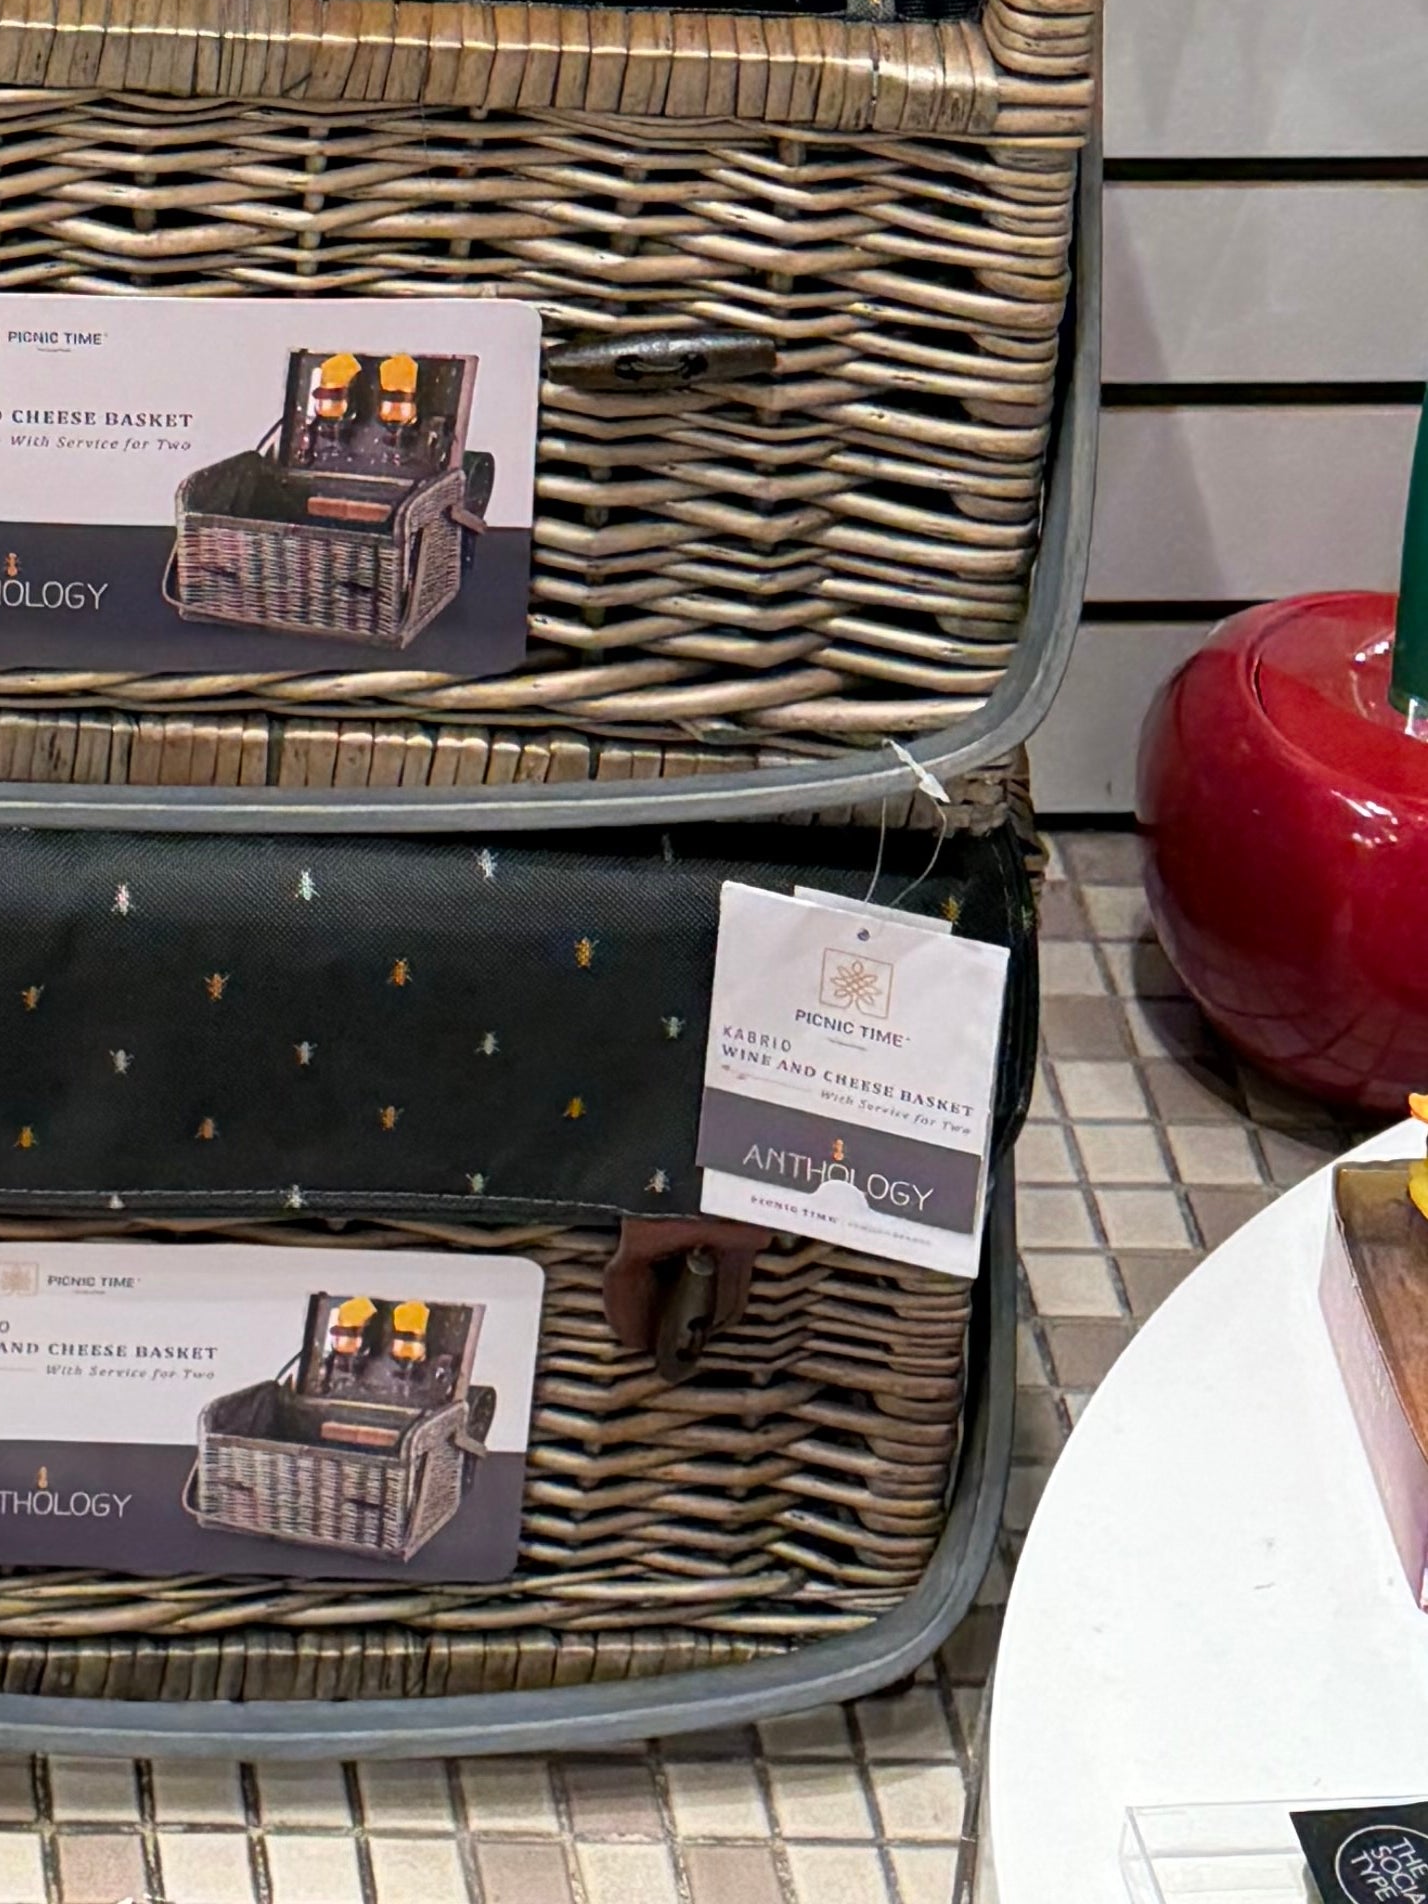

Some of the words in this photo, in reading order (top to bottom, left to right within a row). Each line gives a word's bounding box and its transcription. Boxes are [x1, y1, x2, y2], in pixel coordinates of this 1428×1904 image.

[7, 330, 59, 346] PICNIC
[63, 331, 103, 347] TIME
[11, 410, 96, 427] CHEESE
[104, 412, 194, 429] BASKET
[10, 434, 48, 449] With
[56, 435, 117, 451] Service
[123, 434, 148, 454] for
[156, 437, 192, 452] Two
[723, 1024, 792, 1053] KABRIO
[795, 1008, 855, 1036] PICNIC
[858, 1024, 906, 1049] TIME
[722, 1044, 772, 1067] WINE
[777, 1059, 817, 1079] AND
[823, 1070, 894, 1099] CHEESE
[901, 1089, 974, 1119] BASKET
[820, 1090, 854, 1107] With
[858, 1098, 910, 1121] Service
[913, 1108, 938, 1128] for
[941, 1119, 972, 1136] Two
[743, 1143, 935, 1212] ANTHOLOGY
[751, 1195, 799, 1213] PICNIC
[47, 1274, 96, 1288] PICNIC
[100, 1275, 136, 1289] TIME
[48, 1343, 129, 1359] CHEESE
[136, 1345, 219, 1361] BASKET
[46, 1364, 83, 1378] With
[89, 1364, 147, 1380] Service
[152, 1364, 176, 1382] for
[184, 1367, 215, 1381] Two
[1392, 1836, 1428, 1879] THE
[1351, 1850, 1398, 1902] TYPE
